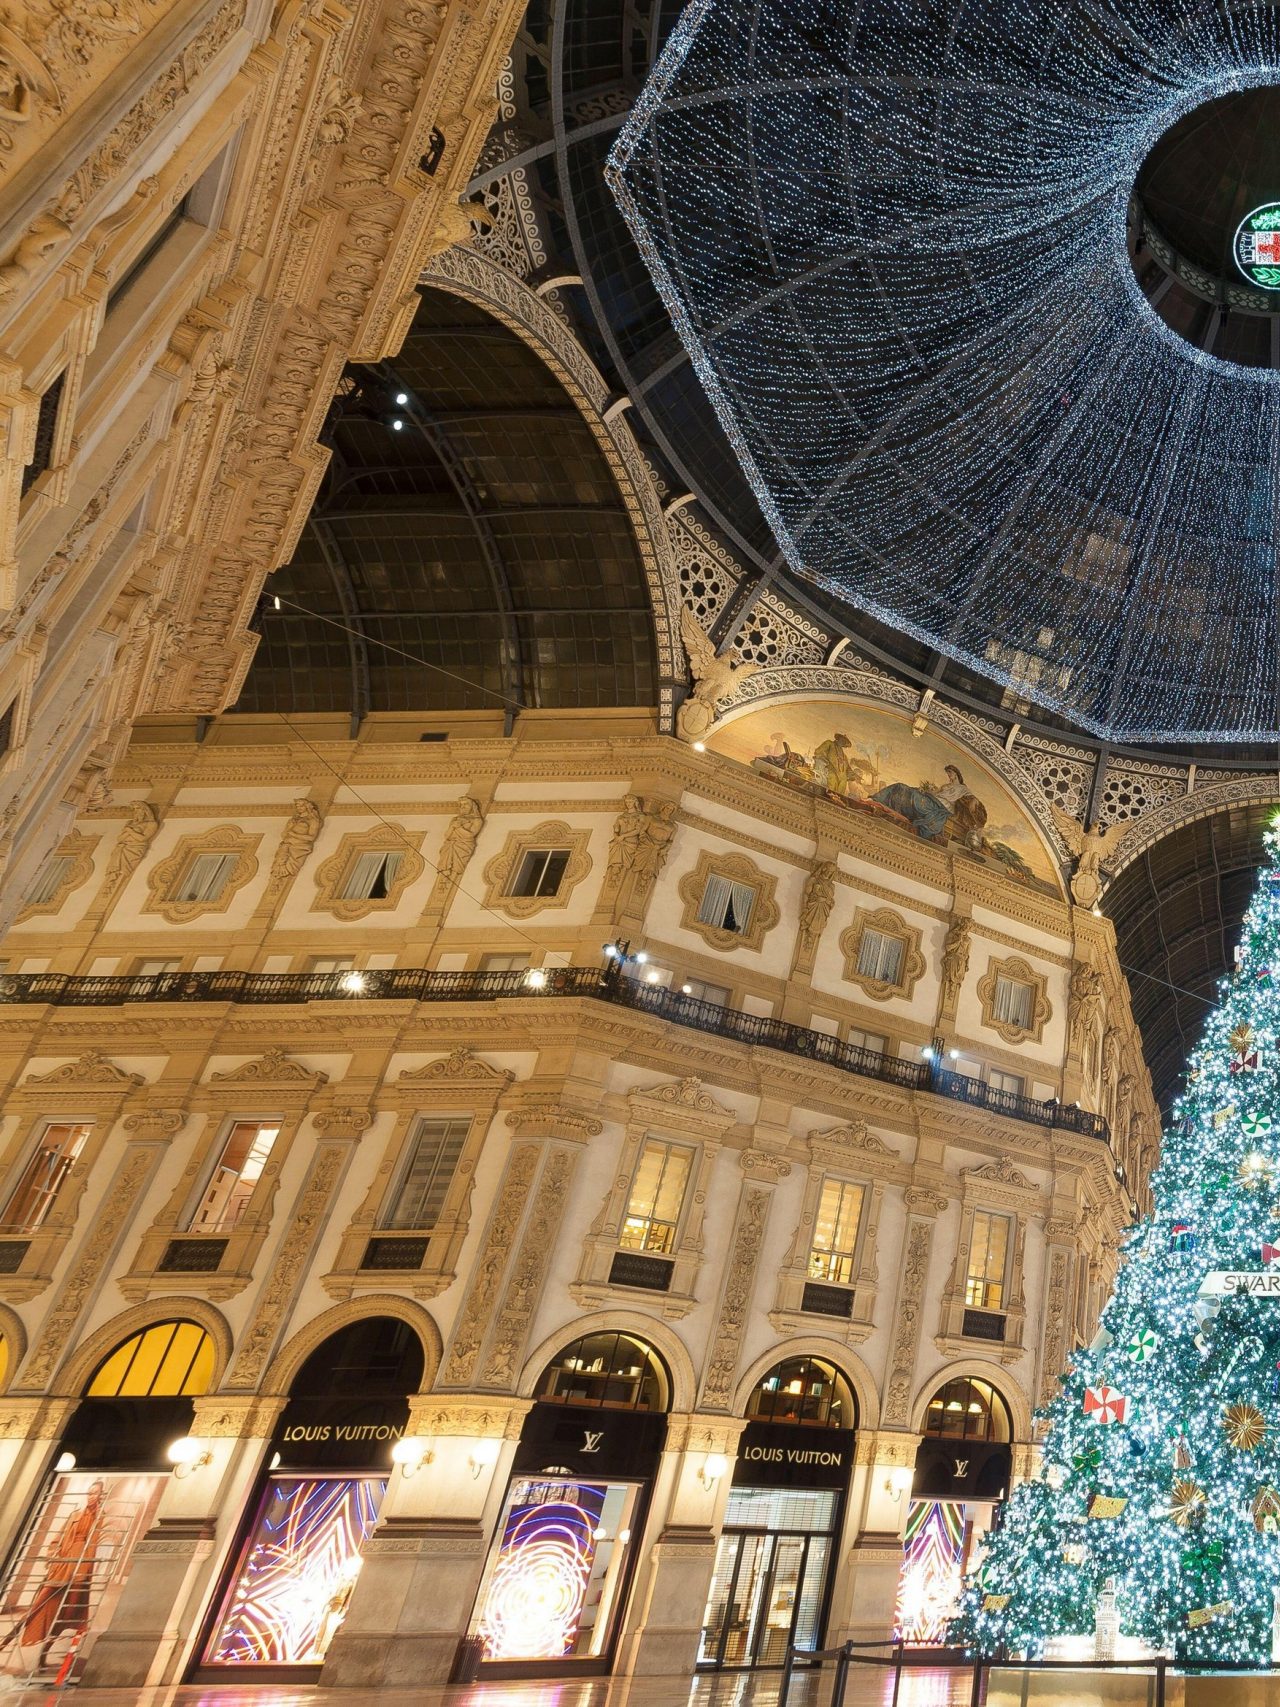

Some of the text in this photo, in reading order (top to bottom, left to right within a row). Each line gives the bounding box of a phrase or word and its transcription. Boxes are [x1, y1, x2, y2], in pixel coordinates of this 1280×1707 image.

[283, 1425, 404, 1441] LOUIS VUITTON
[744, 1446, 842, 1466] LOUIS VUITTON
